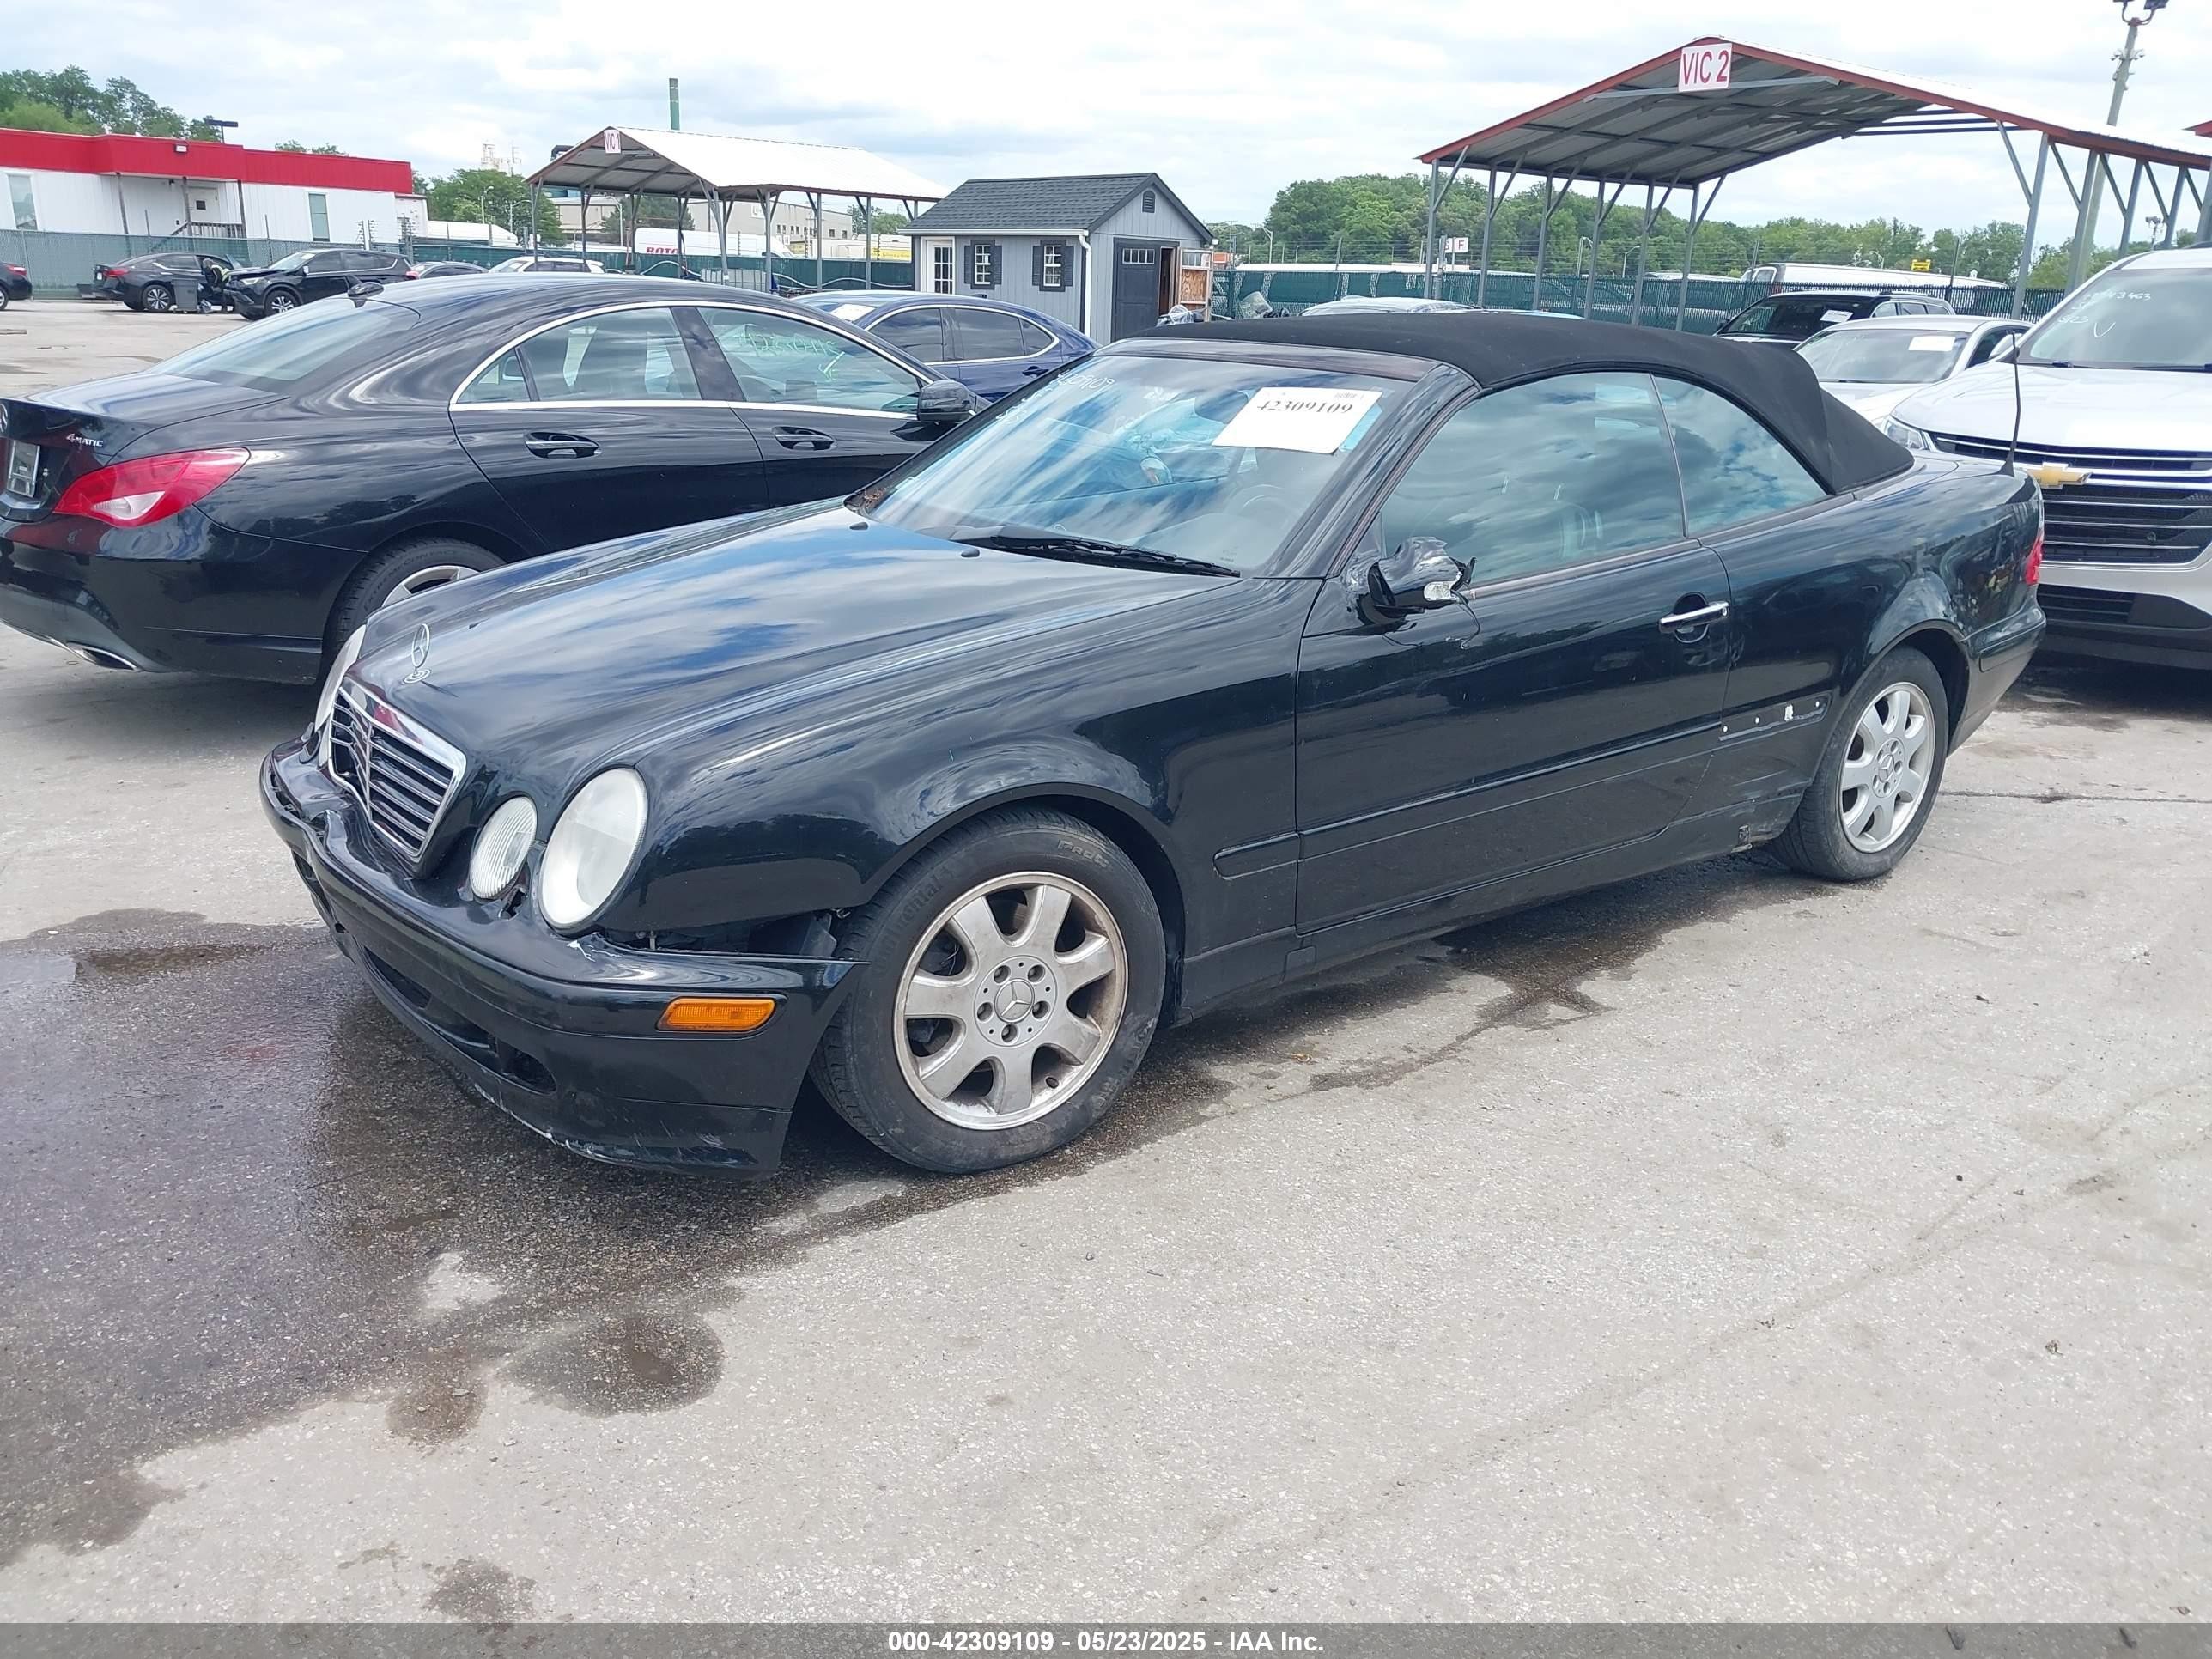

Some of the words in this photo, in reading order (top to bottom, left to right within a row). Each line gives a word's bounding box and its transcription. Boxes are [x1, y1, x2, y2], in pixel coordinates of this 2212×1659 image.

[1682, 51, 1712, 85] VIC
[1717, 49, 1729, 82] 2
[605, 132, 616, 151] VIC
[1458, 240, 1465, 250] F
[1256, 399, 1354, 414] 42309109
[66, 433, 104, 447] 4MATIC
